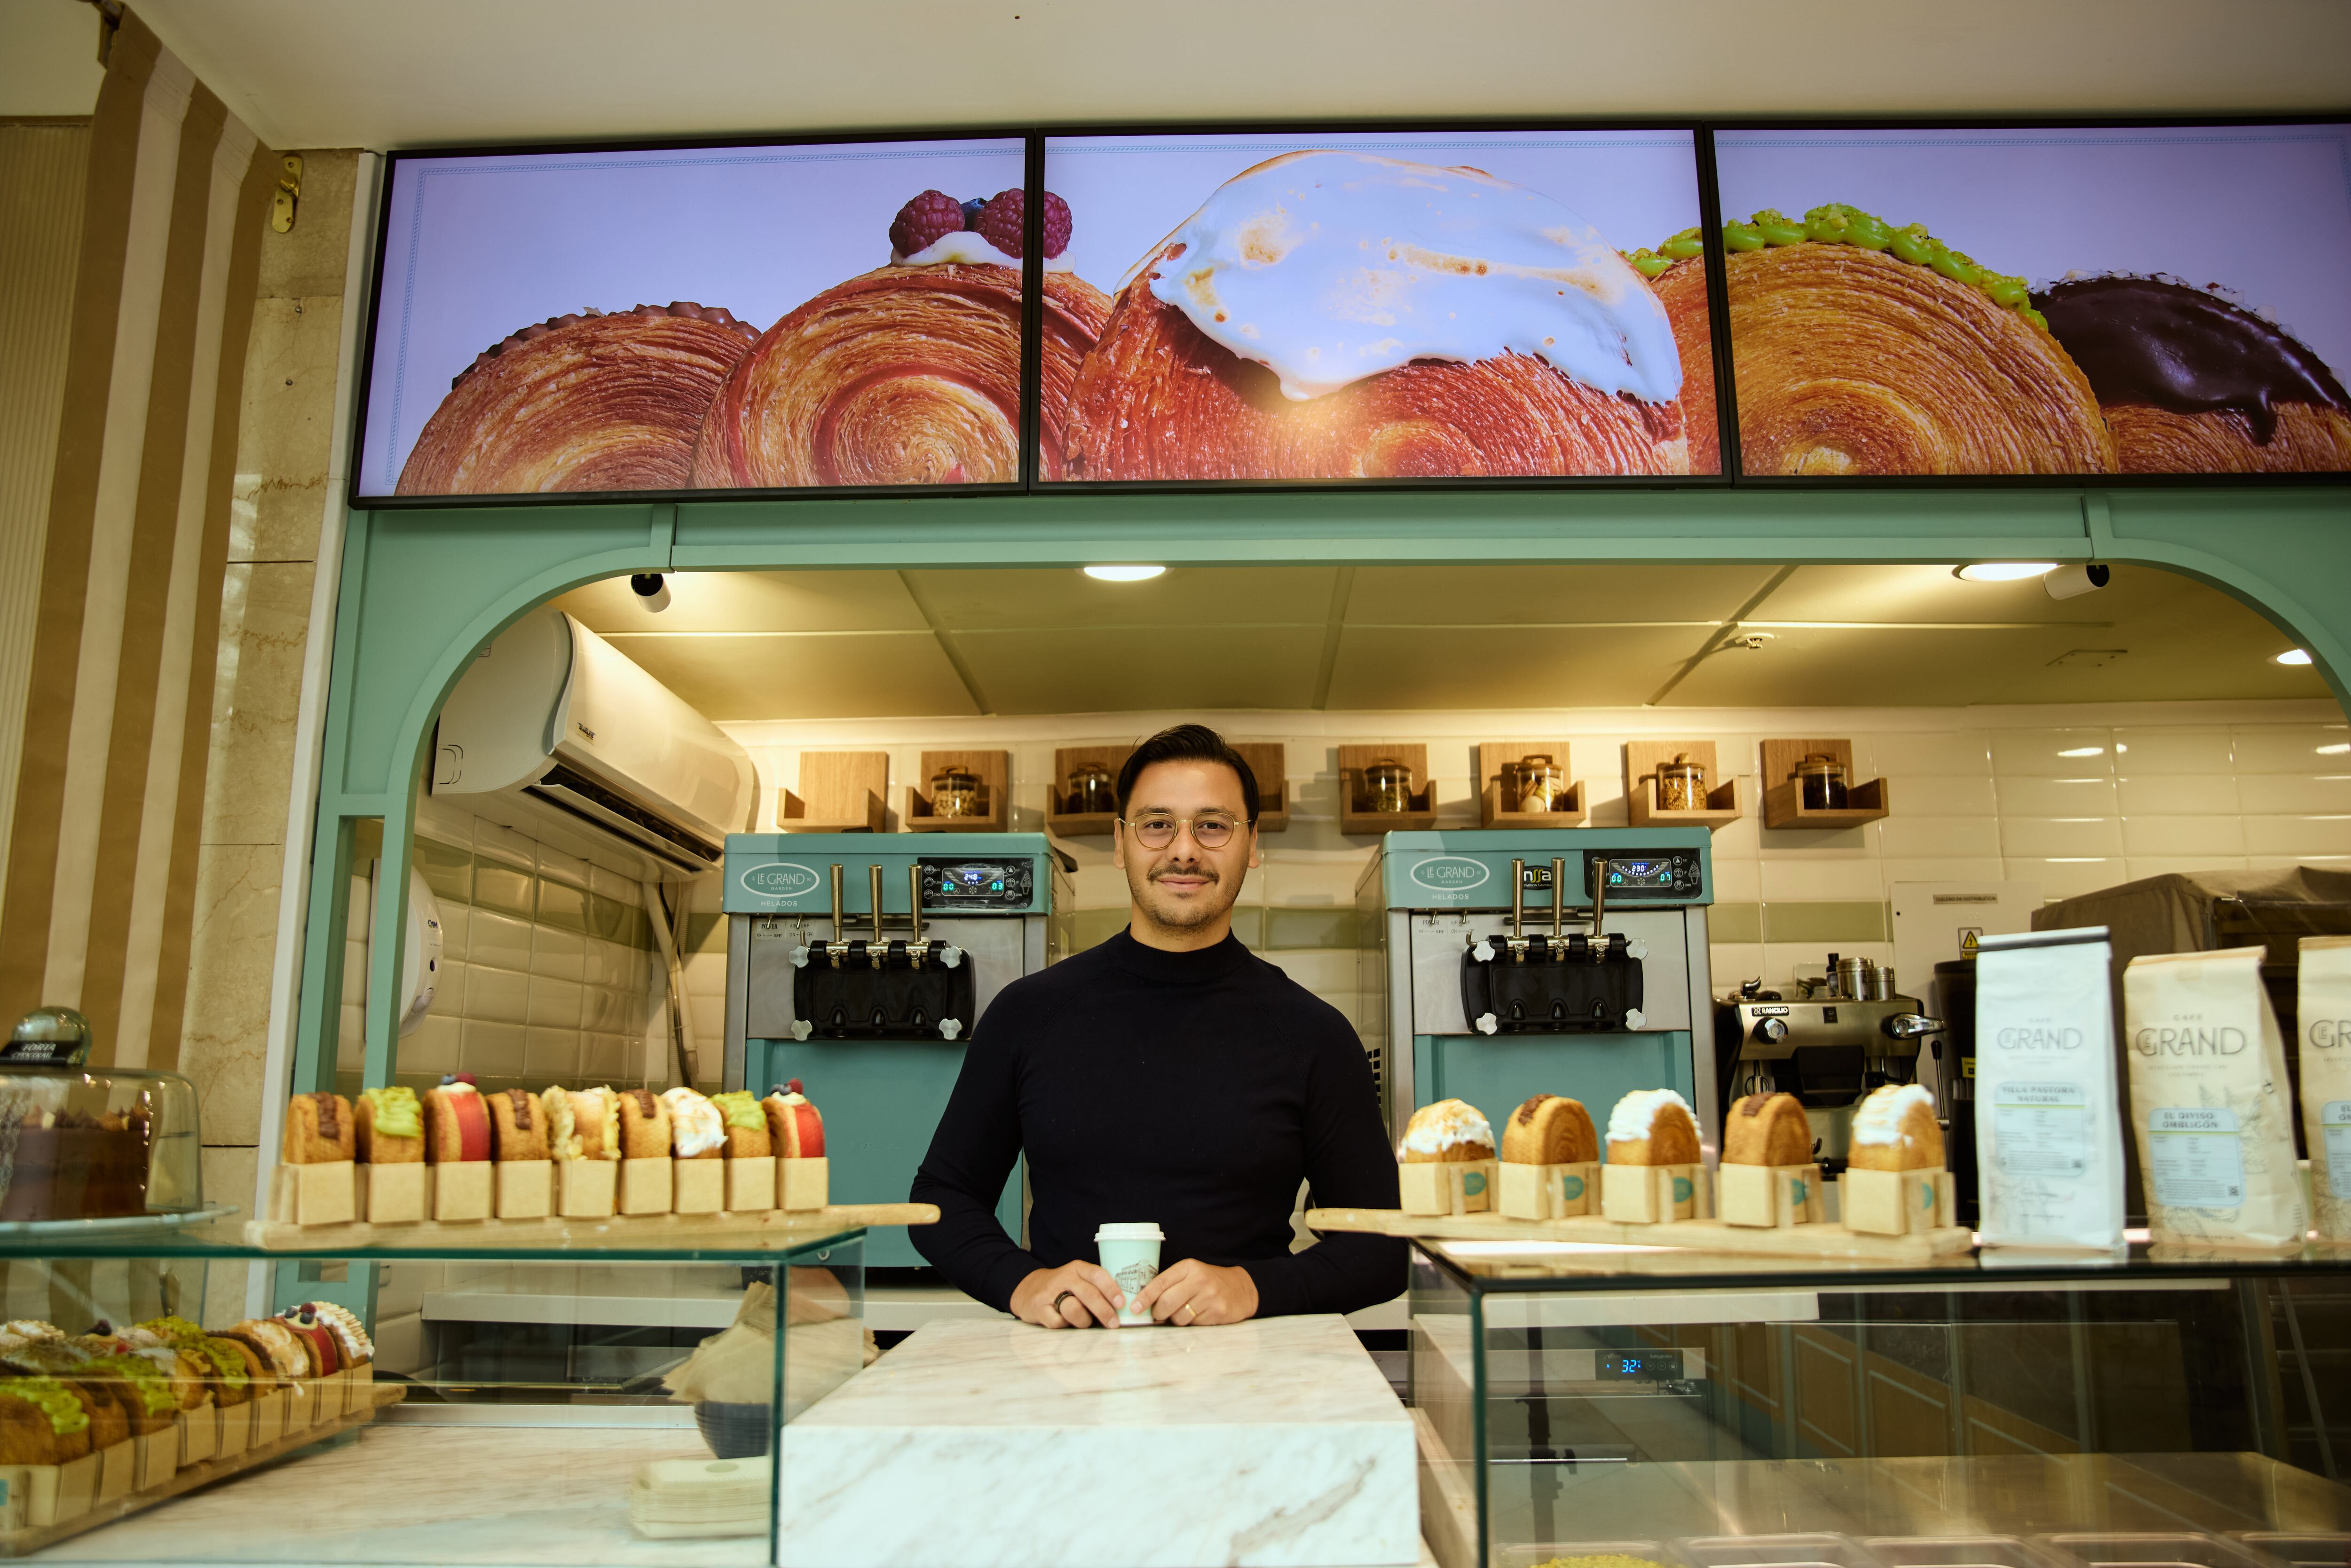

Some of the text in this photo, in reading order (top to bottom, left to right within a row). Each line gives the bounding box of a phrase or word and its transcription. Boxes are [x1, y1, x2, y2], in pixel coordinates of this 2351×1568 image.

[757, 873, 765, 884] LE
[767, 873, 805, 884] GRAND
[1427, 867, 1434, 878] LE
[1437, 867, 1475, 878] GRAND
[1997, 1027, 2083, 1049] GRAND
[2136, 1027, 2246, 1056] GRAND
